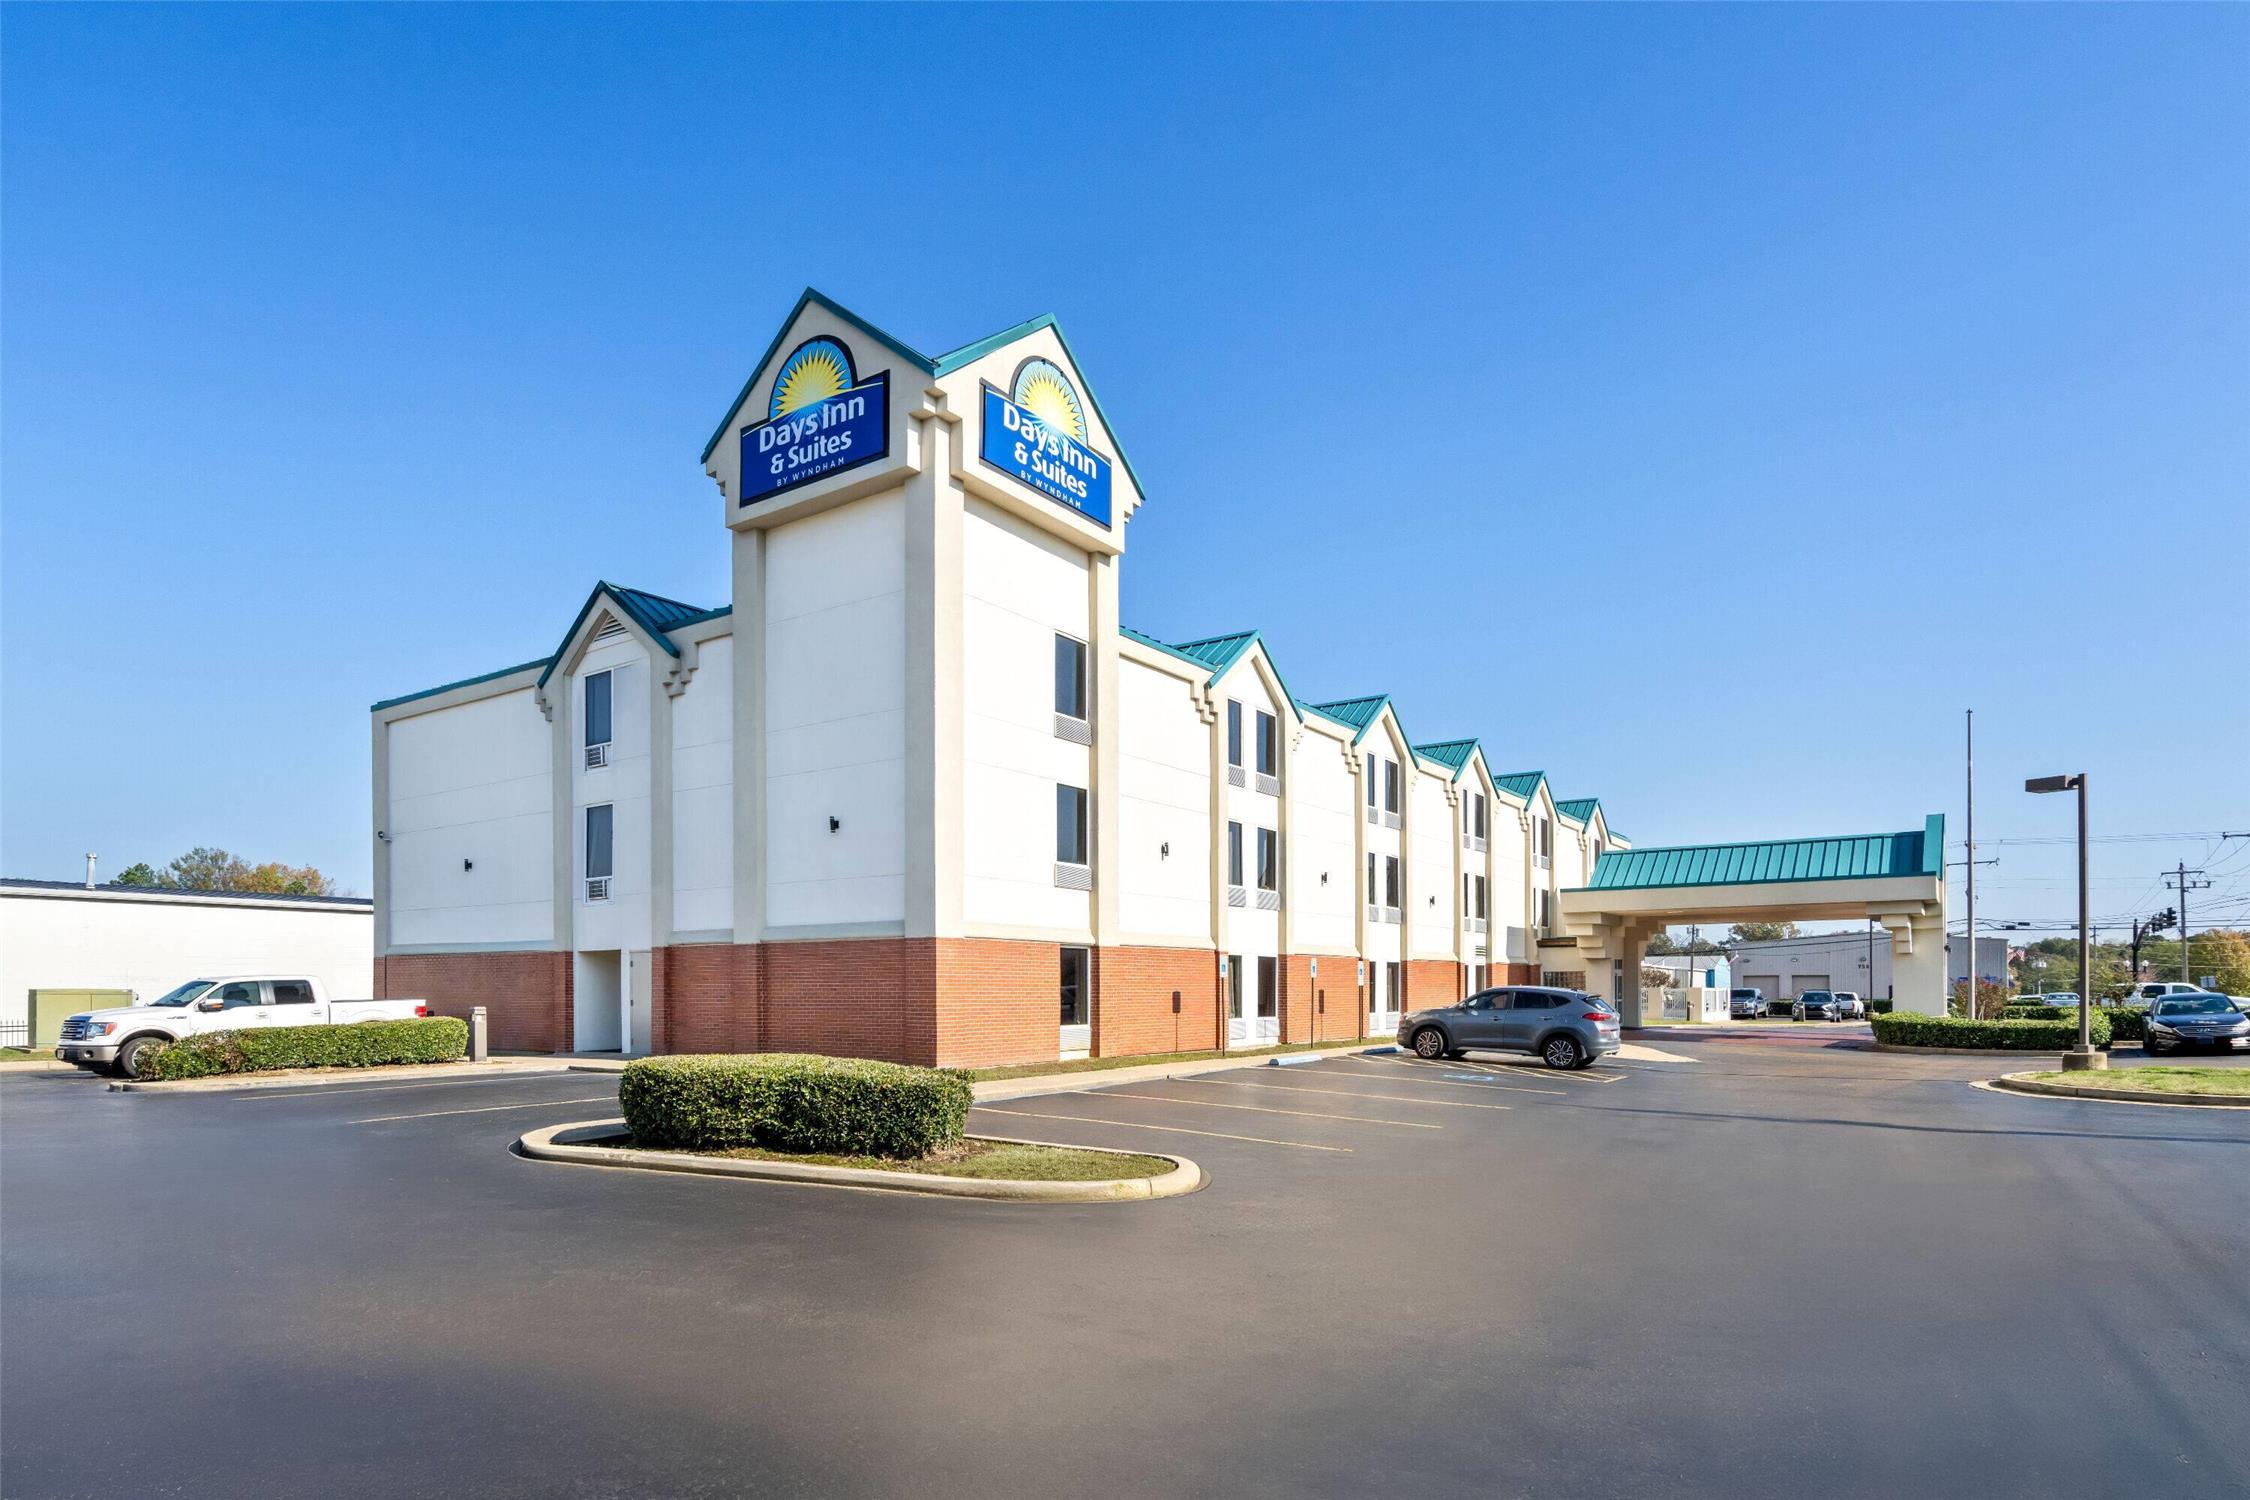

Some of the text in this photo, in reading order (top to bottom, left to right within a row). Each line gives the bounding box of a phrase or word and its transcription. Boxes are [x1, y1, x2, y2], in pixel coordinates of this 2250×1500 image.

[759, 396, 865, 453] Days Inn
[1003, 400, 1097, 480] Days Inn
[770, 430, 852, 475] & Suites
[776, 456, 845, 487] BY WYNDHAM
[1014, 441, 1088, 498] & Suites
[1020, 470, 1081, 509] BY WYNDHAM
